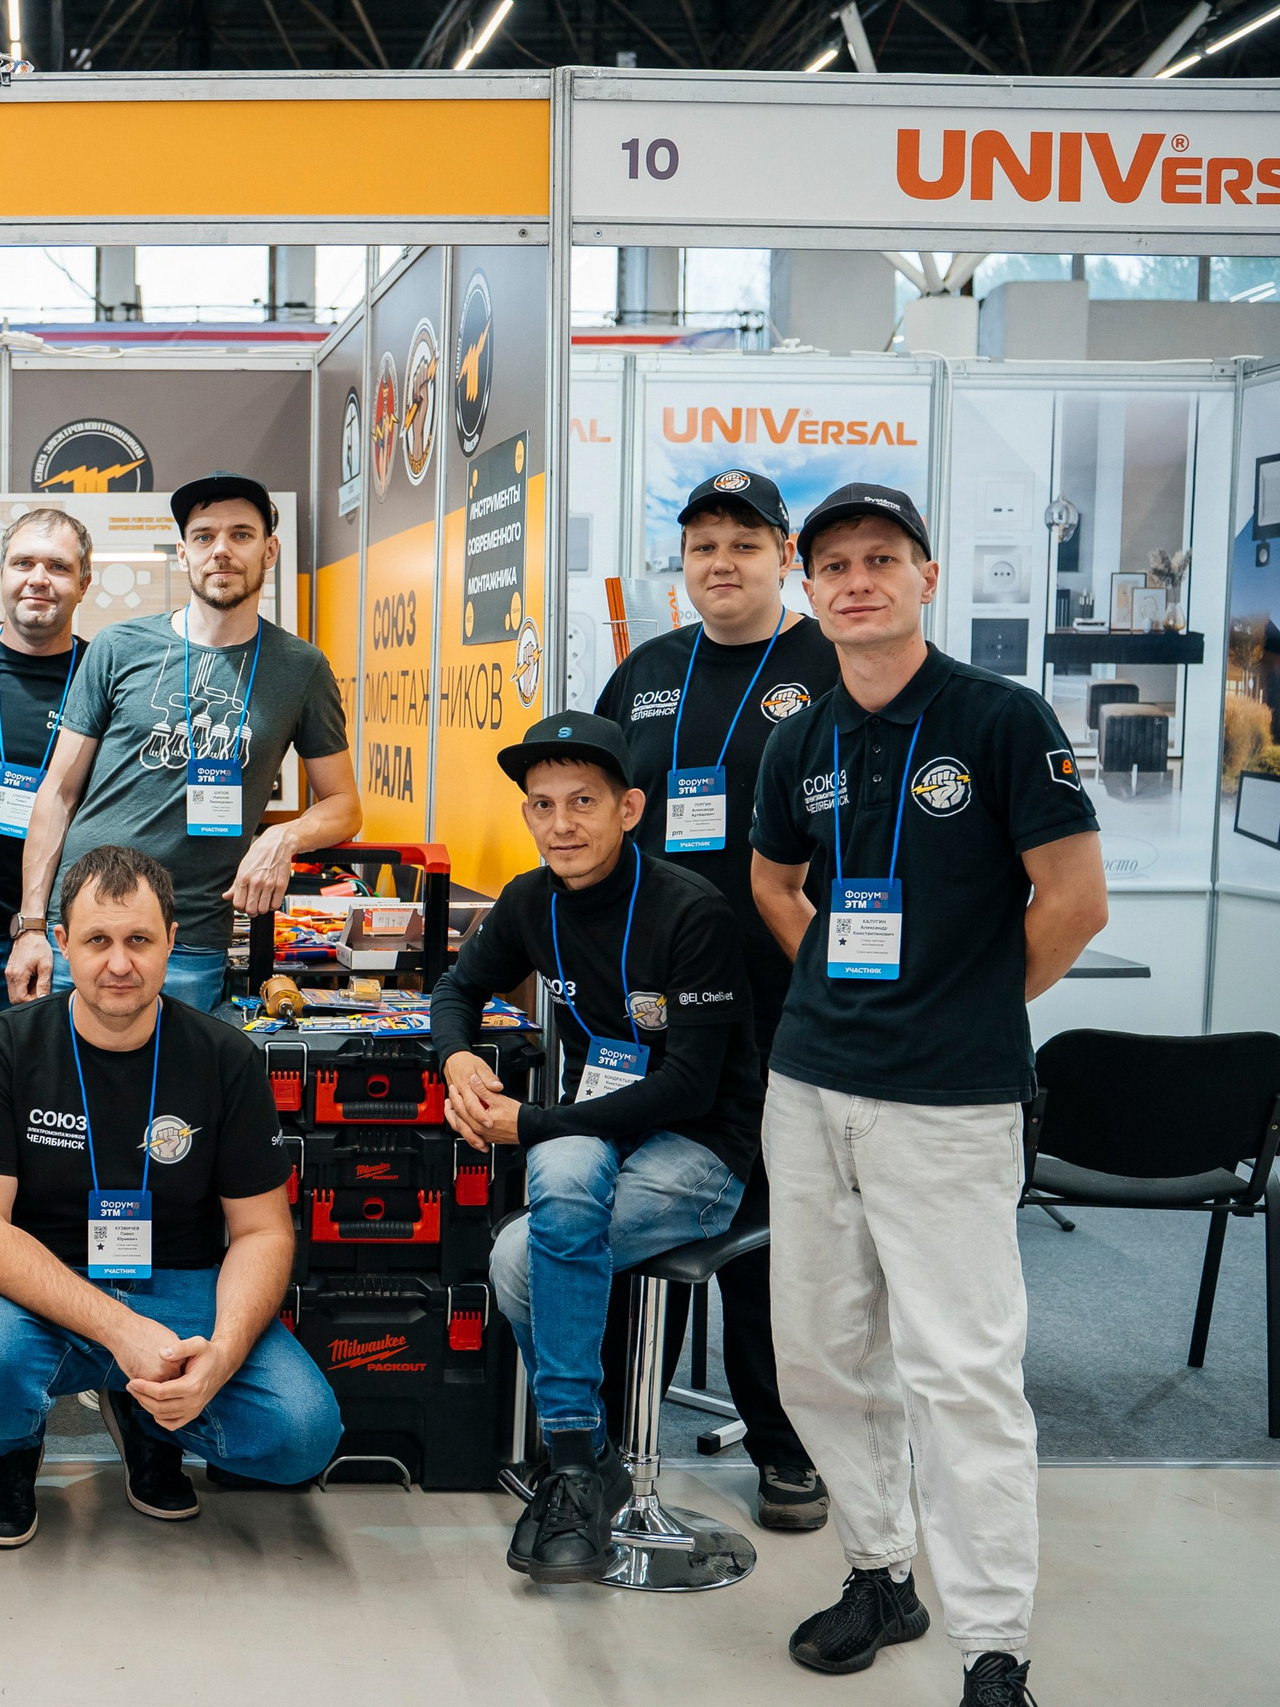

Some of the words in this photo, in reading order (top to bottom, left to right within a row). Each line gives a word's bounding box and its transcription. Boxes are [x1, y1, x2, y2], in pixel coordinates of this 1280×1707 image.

[621, 138, 679, 180] 10
[663, 407, 917, 446] UNIVERSAL
[469, 483, 520, 521] ИНСТРУМЕНТЫ
[467, 521, 521, 556] СОВРЕМЕННОГО
[467, 566, 517, 595] МОНТАЖНИКА
[373, 590, 416, 650] СОЮЗ
[633, 688, 680, 707] СОЮЗ
[631, 707, 677, 722] ЧЕЛЯБИНСК
[5, 770, 32, 782] Форум
[197, 768, 226, 776] Форум
[368, 742, 413, 803] УРАЛА
[3, 778, 20, 787] ЭТМ
[678, 778, 709, 786] Форум
[803, 769, 847, 796] СОЮЗ
[678, 787, 697, 795] ЭТМ
[845, 890, 881, 900] Форум
[844, 900, 867, 909] ЭТМ
[598, 1056, 618, 1067] ЭТМ
[600, 1047, 631, 1061] Форум
[29, 1108, 87, 1131] СОЮЗ
[26, 1133, 85, 1150] ЧЕЛЯБИНСК
[101, 1200, 133, 1209] Форум
[327, 1334, 407, 1362] Milwaukee
[367, 1363, 427, 1372] PACKOUT
